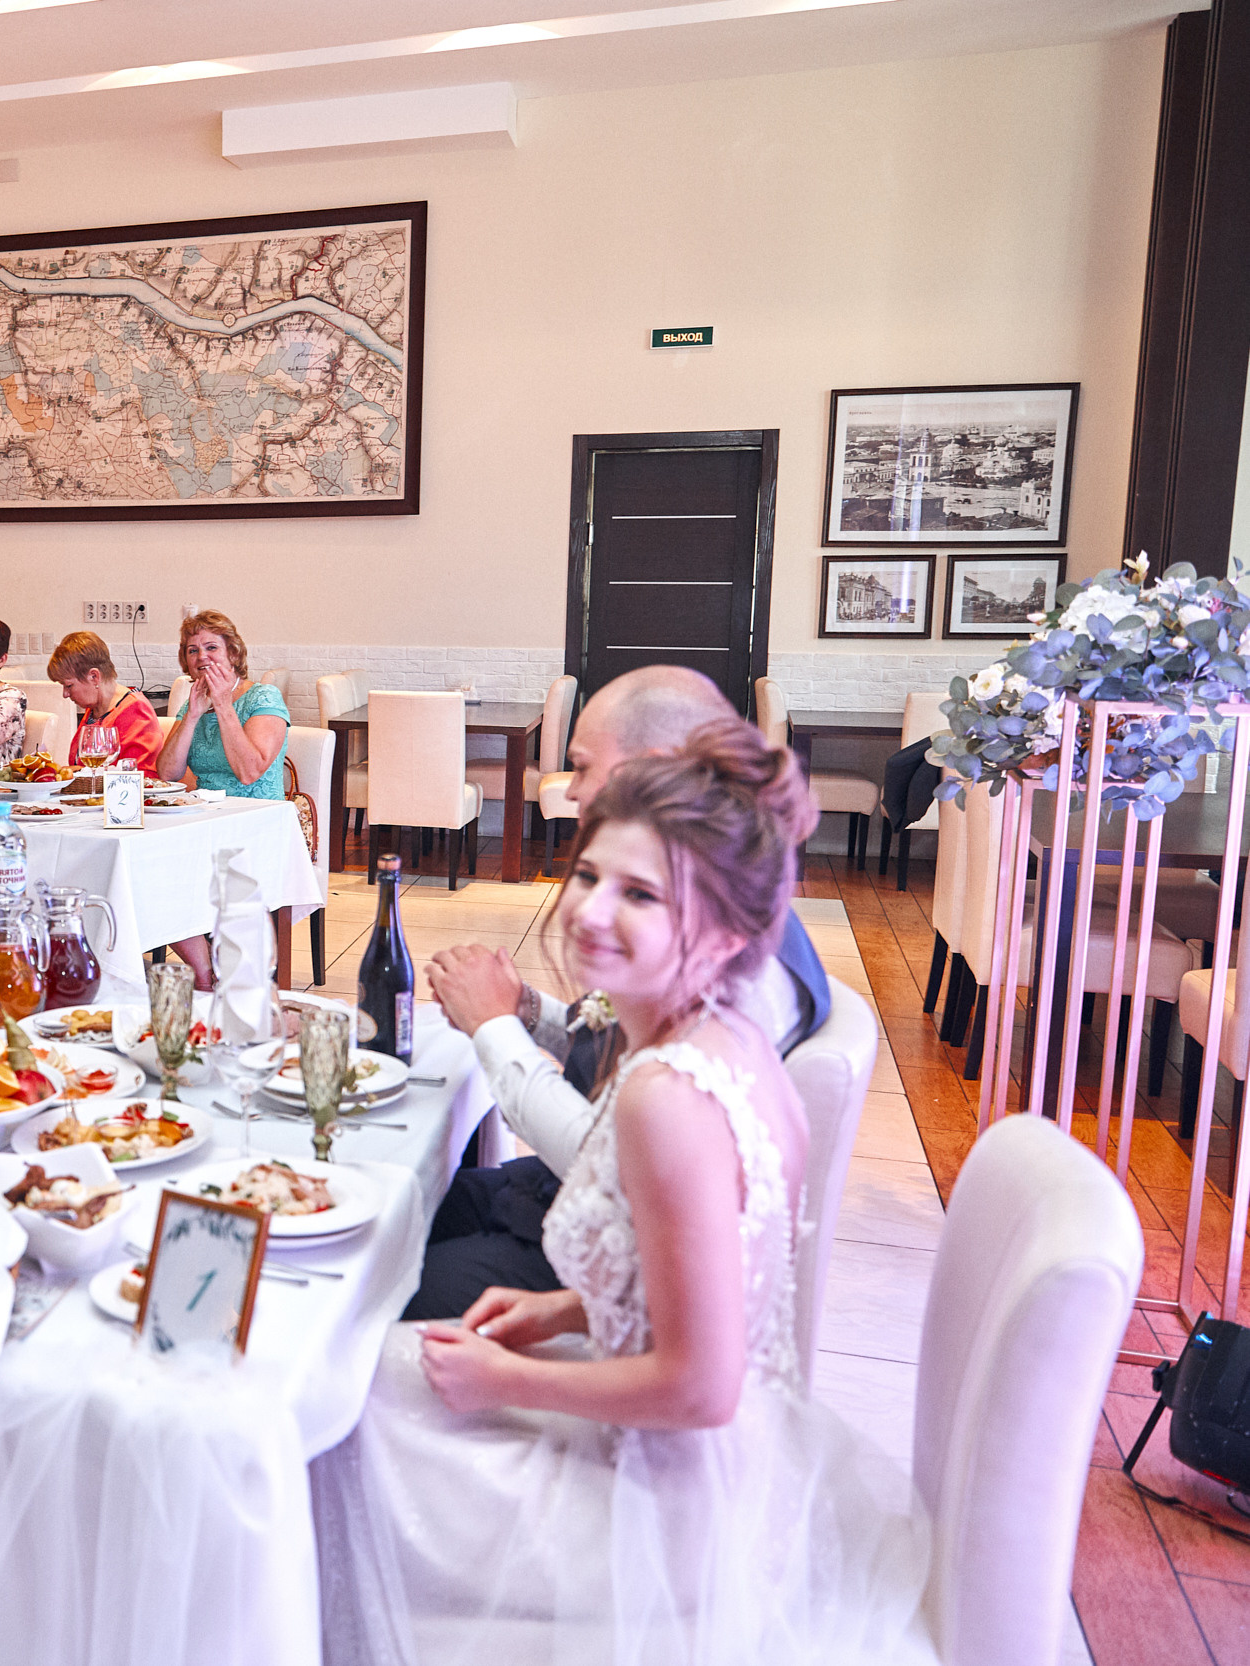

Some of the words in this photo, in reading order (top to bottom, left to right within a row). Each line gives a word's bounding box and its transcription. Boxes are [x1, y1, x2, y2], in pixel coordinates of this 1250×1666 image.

[662, 332, 703, 343] ВЫХОД
[117, 790, 129, 806] 2
[186, 1269, 217, 1311] 1
